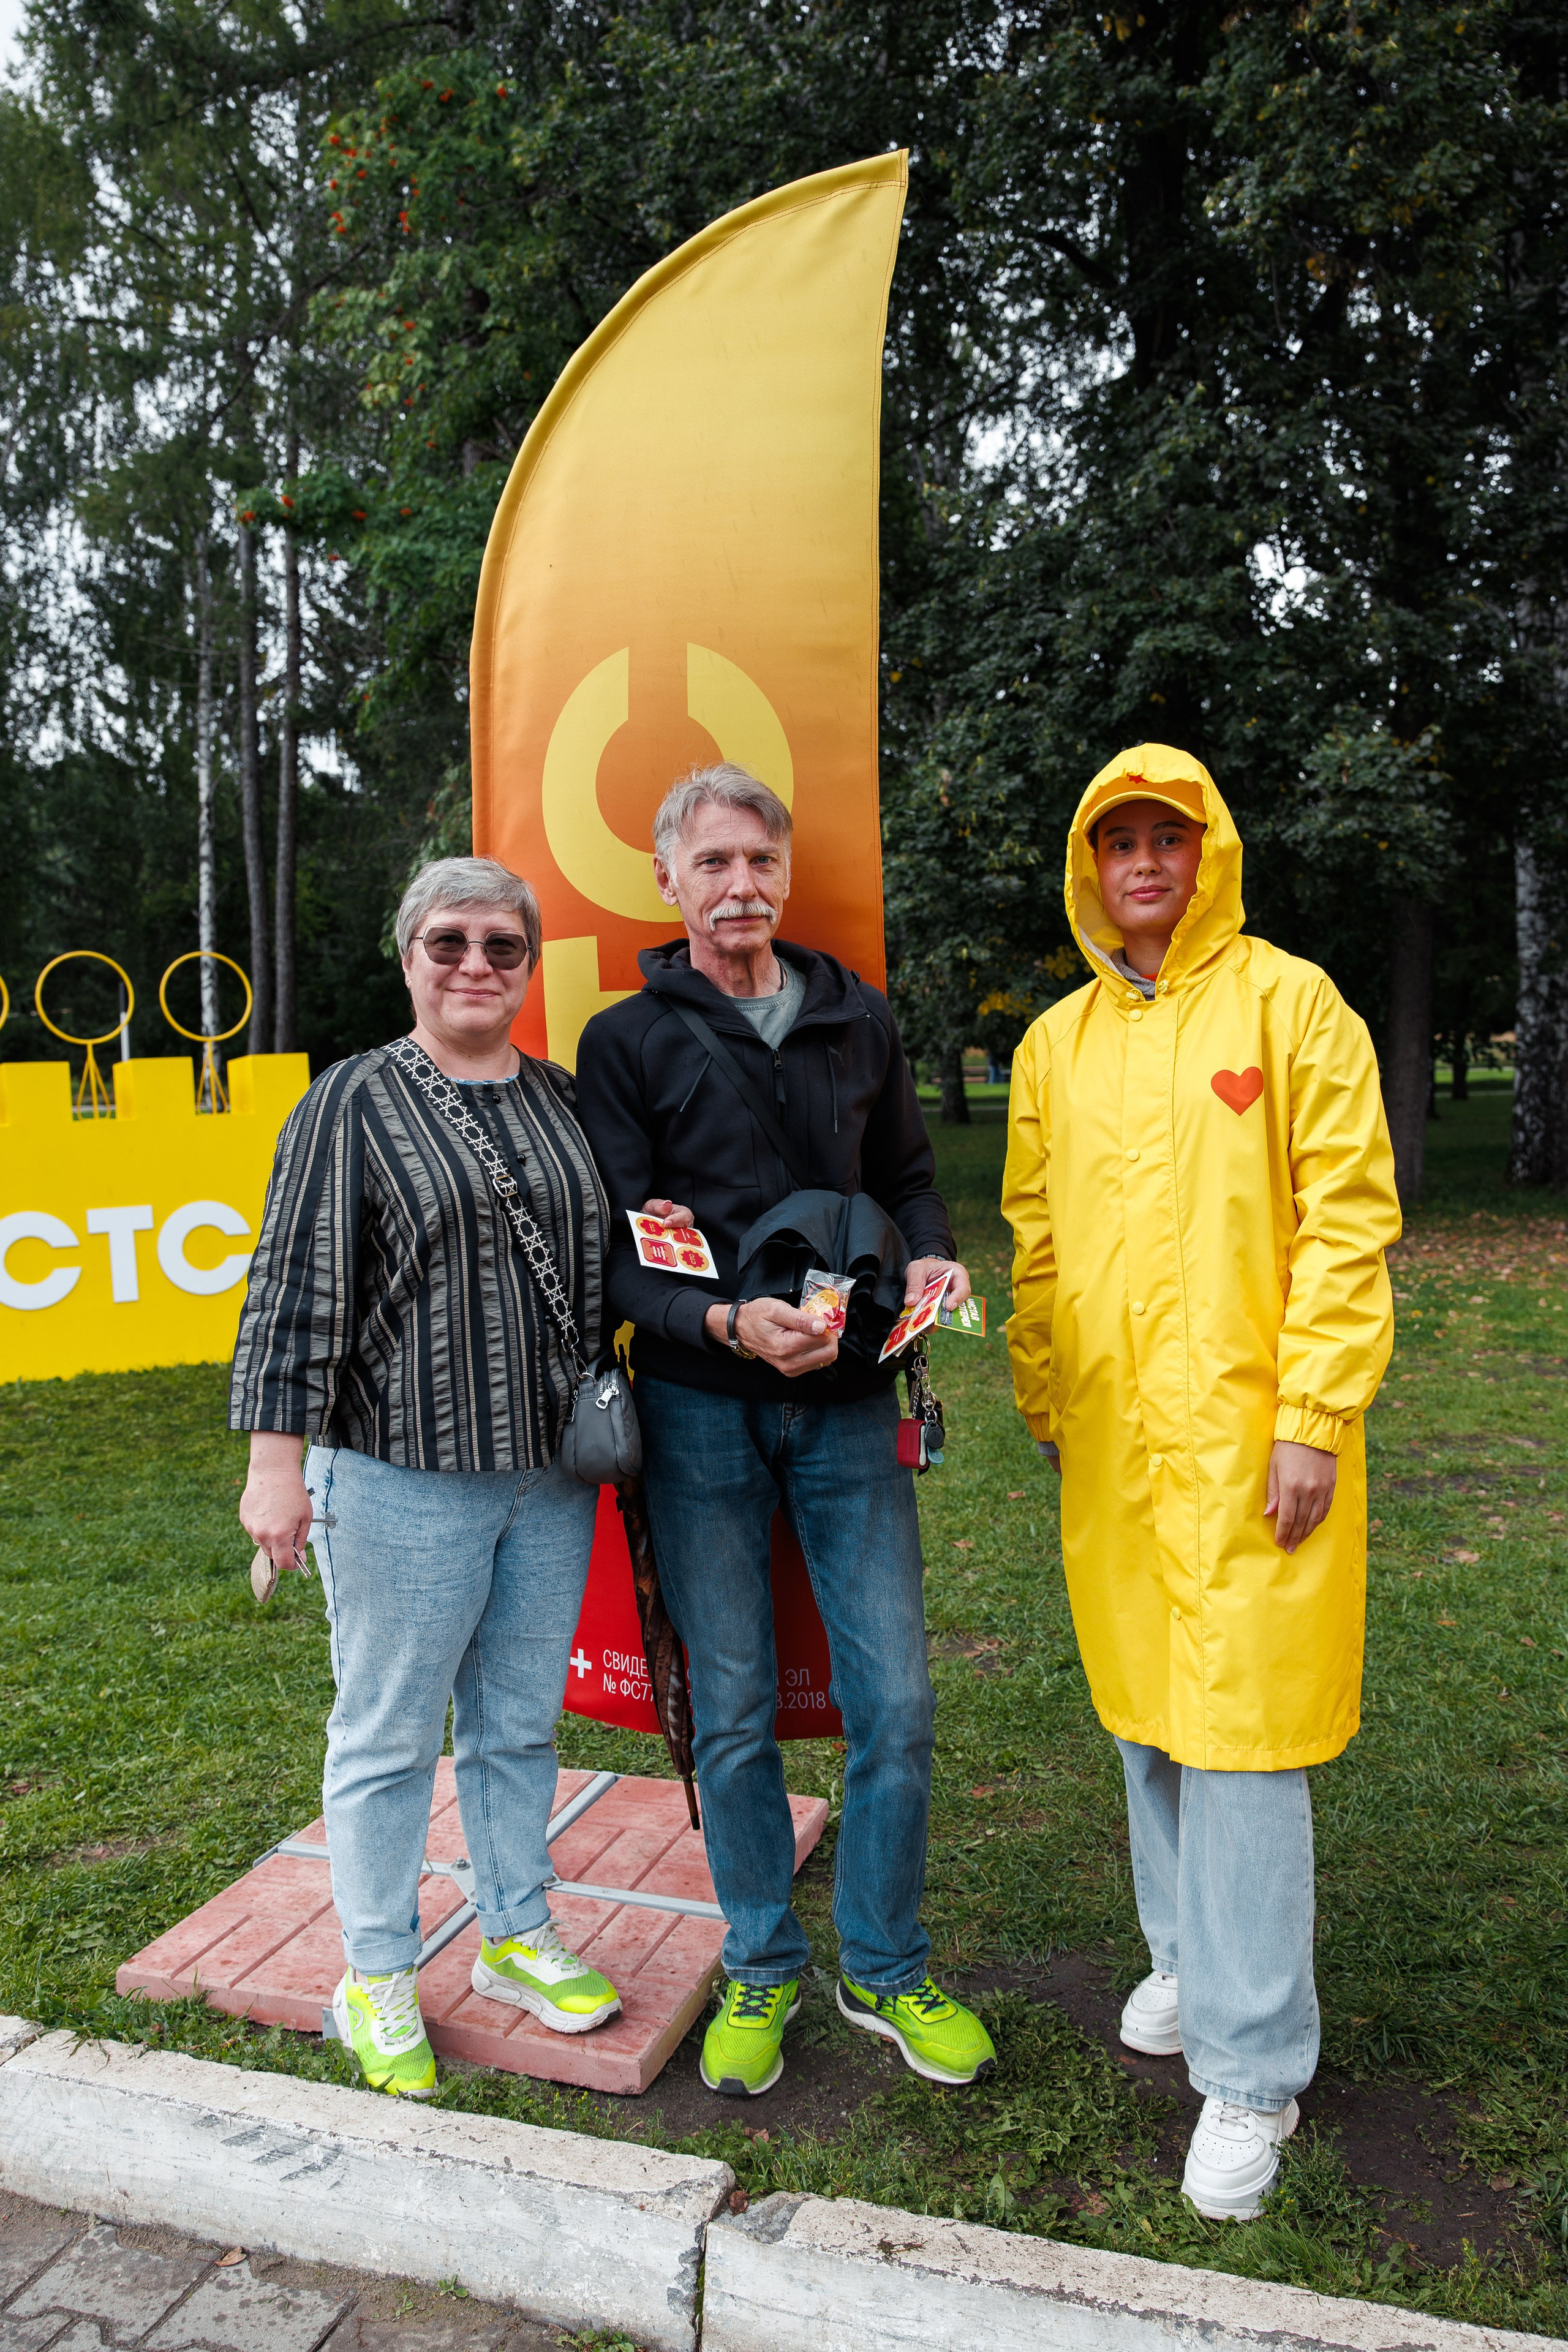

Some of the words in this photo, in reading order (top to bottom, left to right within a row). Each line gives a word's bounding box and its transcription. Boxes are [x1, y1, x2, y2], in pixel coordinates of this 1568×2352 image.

[0, 1200, 252, 1311] СТС
[966, 1298, 980, 1321] ЧИСТАЯ
[603, 1673, 616, 1694] №
[785, 1668, 810, 1687] ЭЛ
